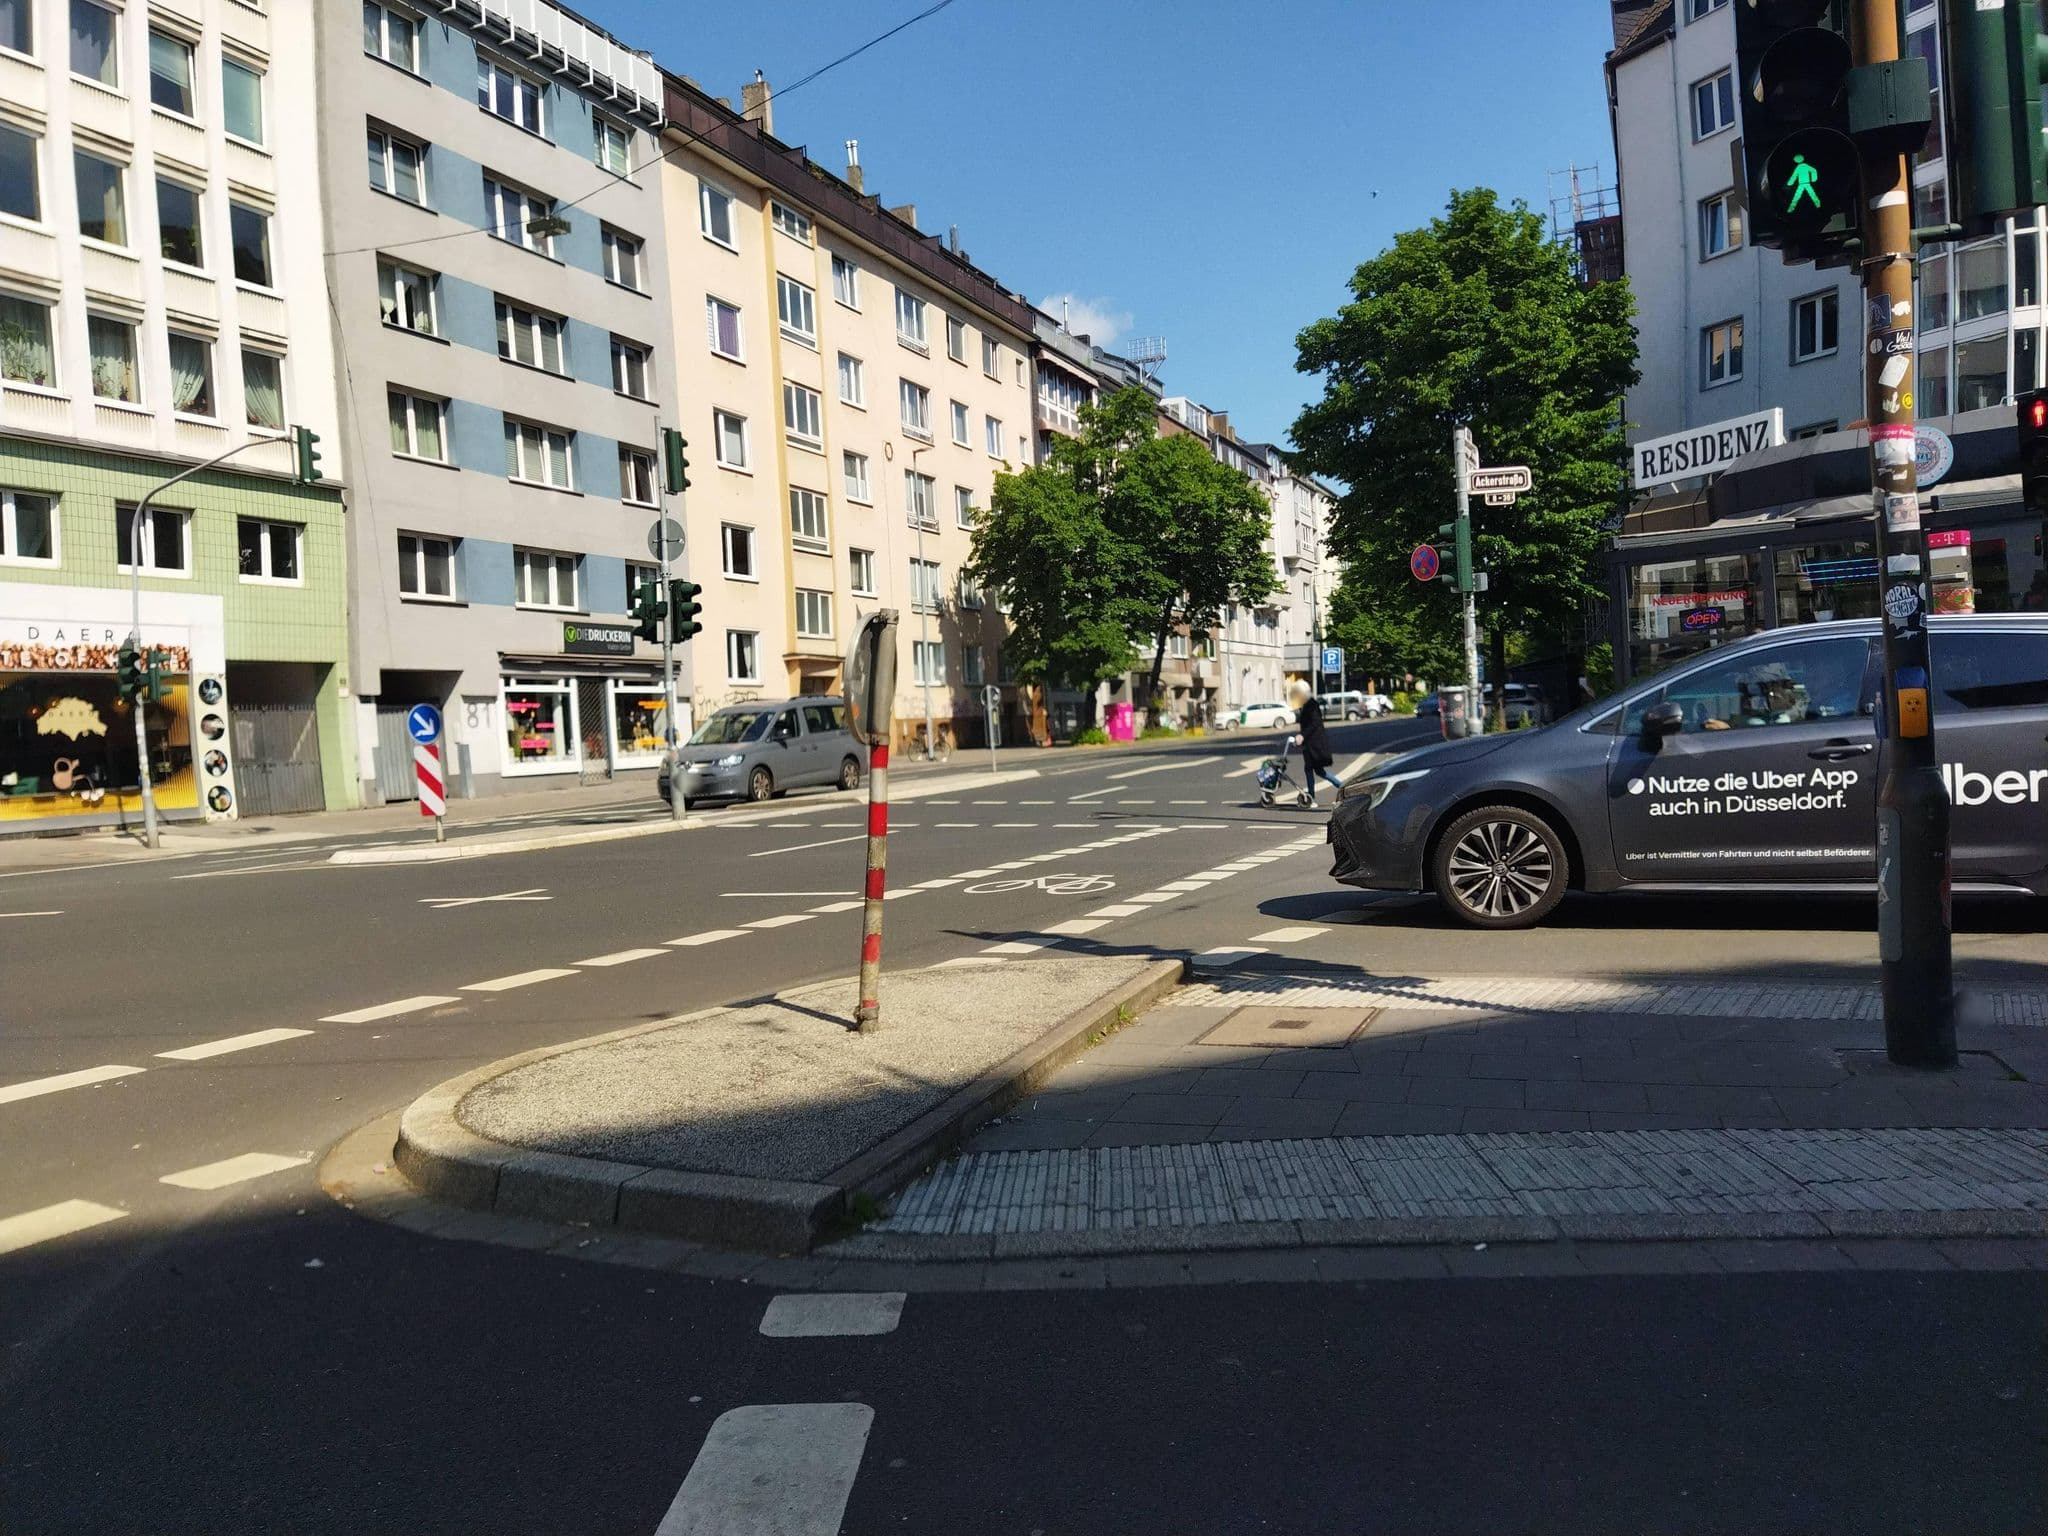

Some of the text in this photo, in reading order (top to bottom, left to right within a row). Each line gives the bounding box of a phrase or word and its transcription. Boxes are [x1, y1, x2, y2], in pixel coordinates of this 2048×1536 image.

[1641, 420, 1769, 479] RESIDENZ
[1475, 473, 1523, 489] Ackerstraße
[1687, 613, 1719, 626] OPEN
[467, 703, 490, 729] 81
[1648, 768, 1858, 794] Nutze die Uber App
[1649, 789, 1847, 816] auch in Düsseldorf.
[1625, 852, 1645, 860] Uber
[1647, 851, 1657, 859] ist
[1658, 850, 1700, 859] Vermittler
[1719, 850, 1752, 858] Fahrten
[1772, 849, 1795, 857] nicht
[1796, 849, 1822, 857] selbst
[1823, 848, 1872, 857] Beförderer.
